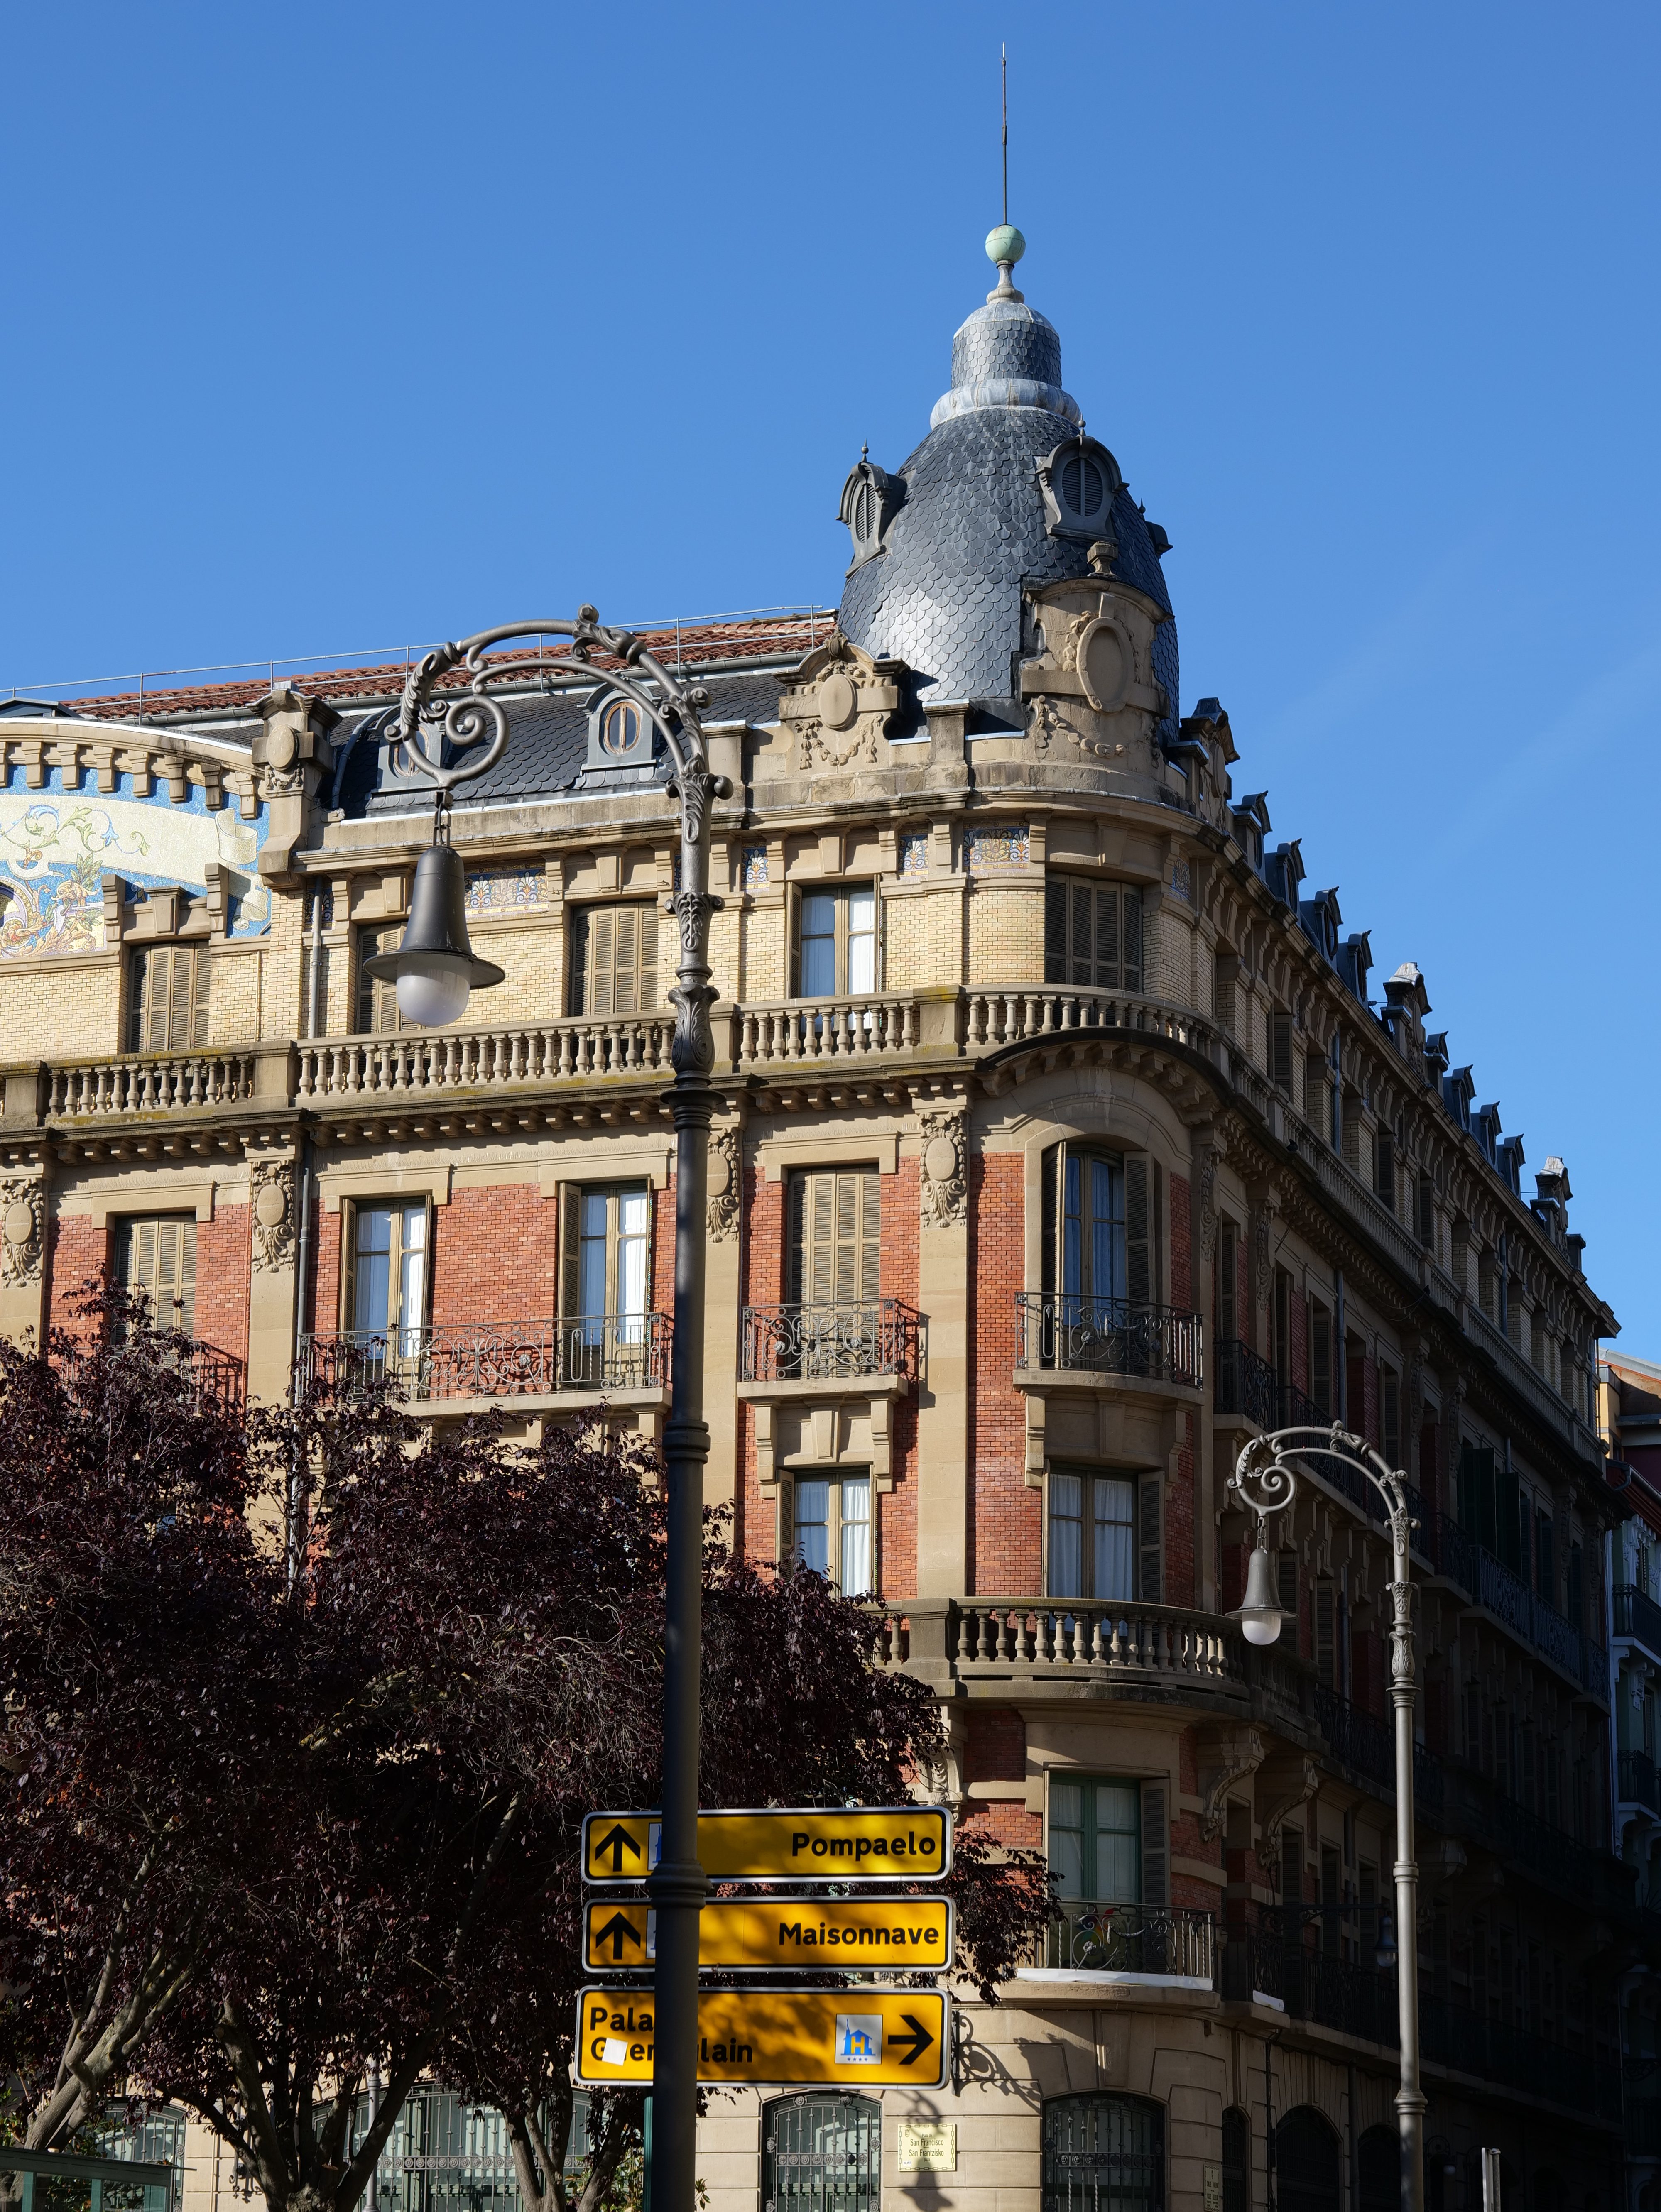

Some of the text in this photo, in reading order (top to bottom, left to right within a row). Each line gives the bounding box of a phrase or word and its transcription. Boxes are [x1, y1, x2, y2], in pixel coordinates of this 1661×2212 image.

[792, 1831, 936, 1862] Pompaelo
[779, 1922, 939, 1945] Maisonnave
[590, 2007, 654, 2032] Pala
